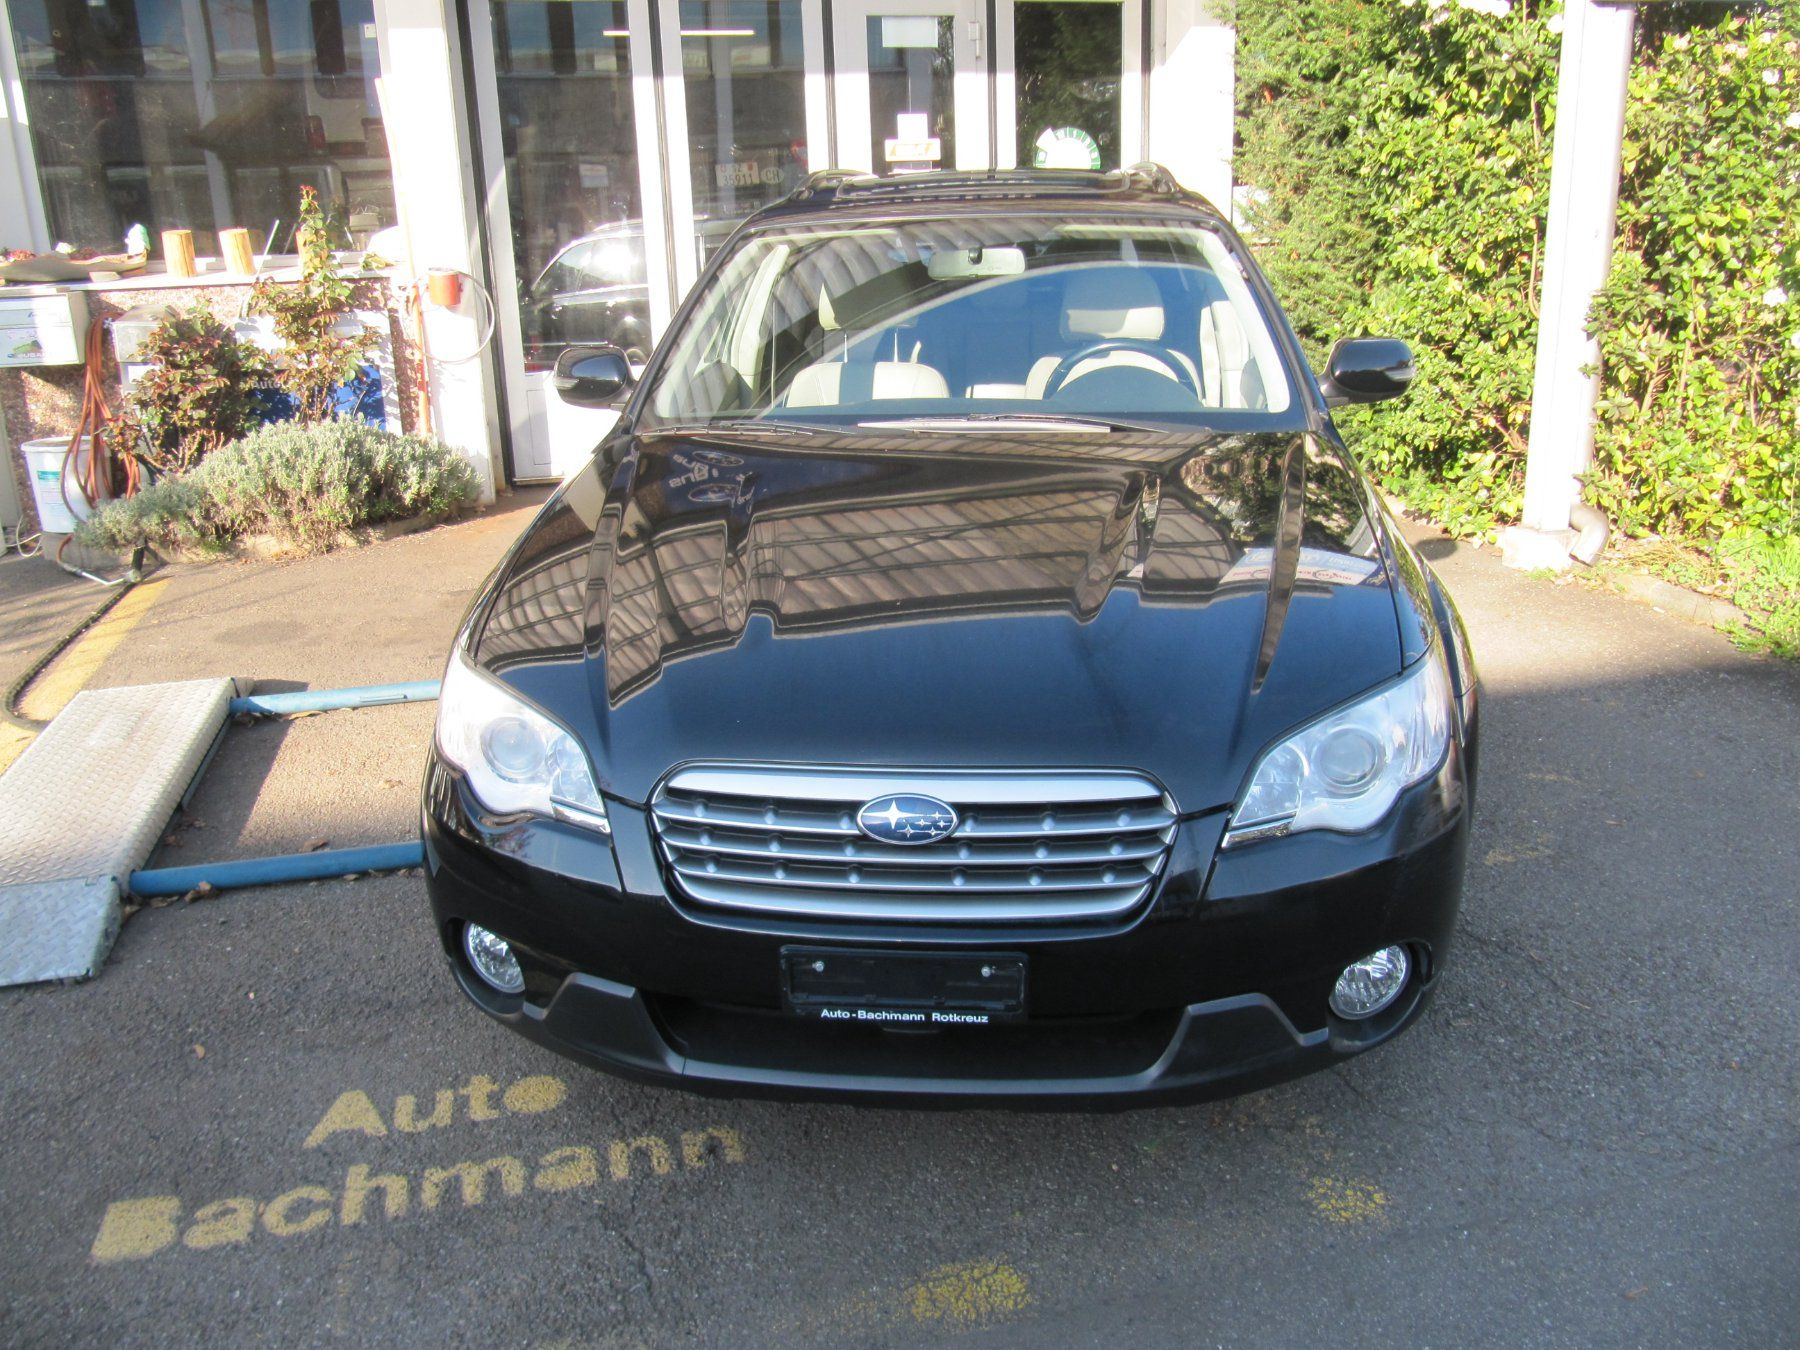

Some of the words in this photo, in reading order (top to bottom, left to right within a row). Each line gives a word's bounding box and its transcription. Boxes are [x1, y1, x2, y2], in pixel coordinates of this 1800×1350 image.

[765, 168, 780, 183] CH
[931, 1012, 990, 1024] Rotkreuz
[303, 1073, 568, 1150] Auto
[89, 1125, 748, 1265] Bachmann
